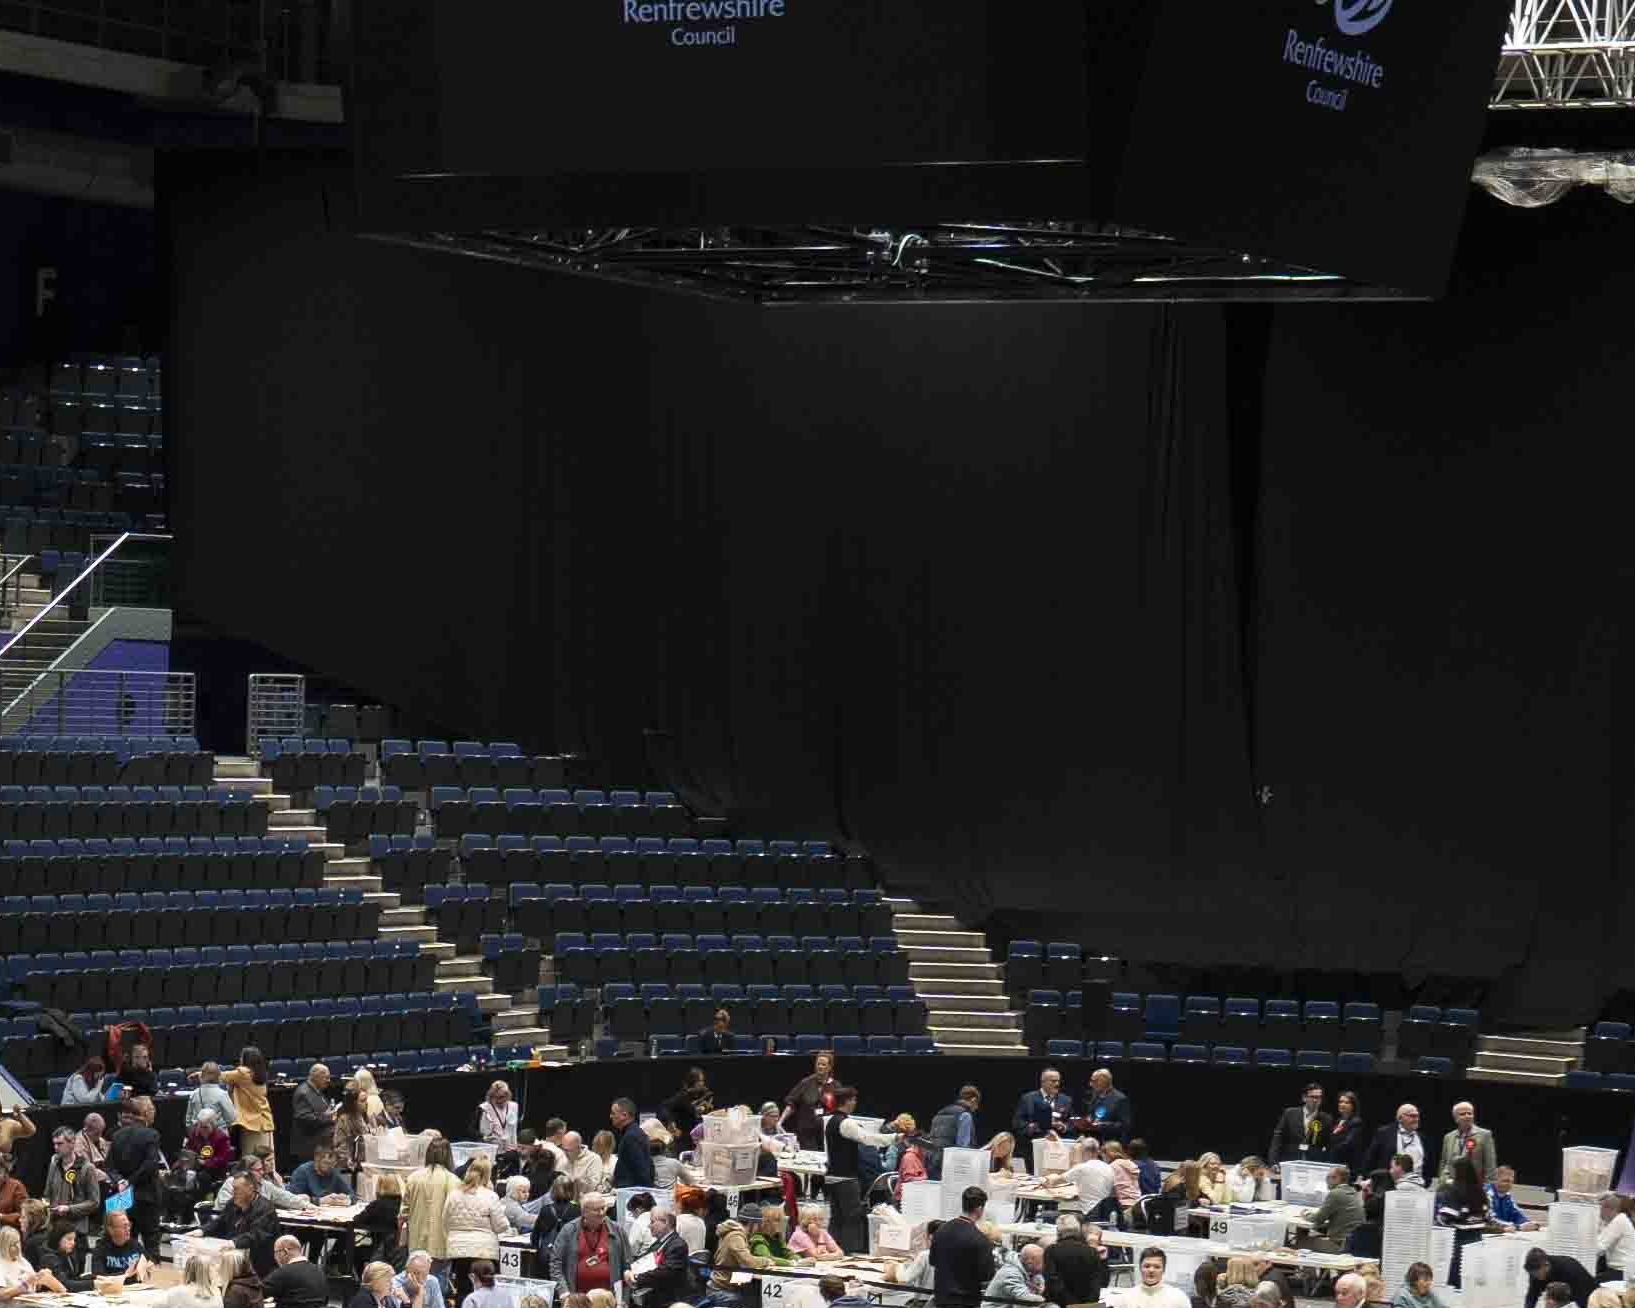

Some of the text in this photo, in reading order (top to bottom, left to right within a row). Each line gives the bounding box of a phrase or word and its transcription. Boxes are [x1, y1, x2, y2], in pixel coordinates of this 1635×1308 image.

[623, 0, 786, 24] Renfrewshire
[671, 26, 736, 46] Council
[1283, 29, 1384, 88] Renfrewshire
[1305, 80, 1348, 112] Council
[33, 266, 58, 319] F
[1210, 1222, 1228, 1234] 49
[501, 1252, 519, 1268] 43
[763, 1284, 782, 1299] 42
